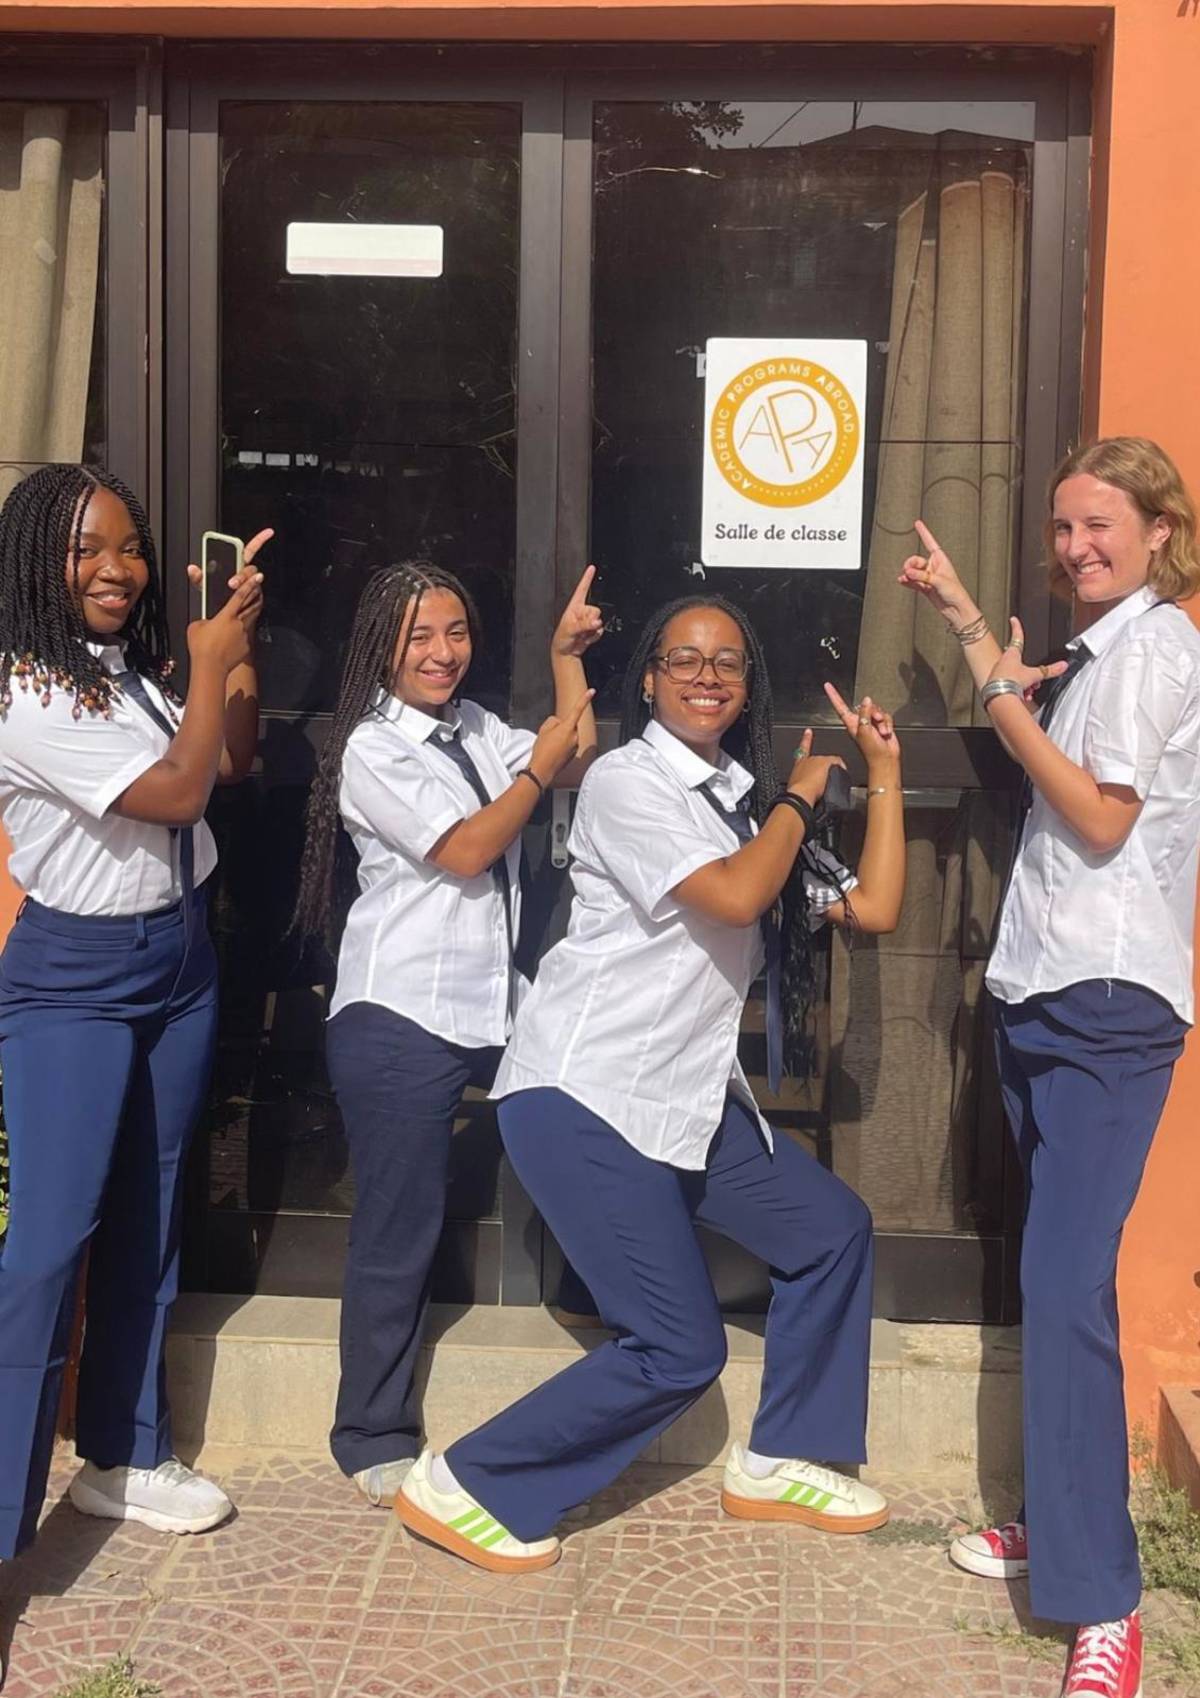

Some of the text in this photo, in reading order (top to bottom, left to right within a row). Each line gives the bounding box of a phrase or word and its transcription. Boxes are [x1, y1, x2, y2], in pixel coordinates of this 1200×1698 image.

[716, 363, 854, 490] ACADEMIC PROGRAMS ABROAD
[739, 388, 832, 473] APA
[715, 523, 847, 541] Salle de classe
